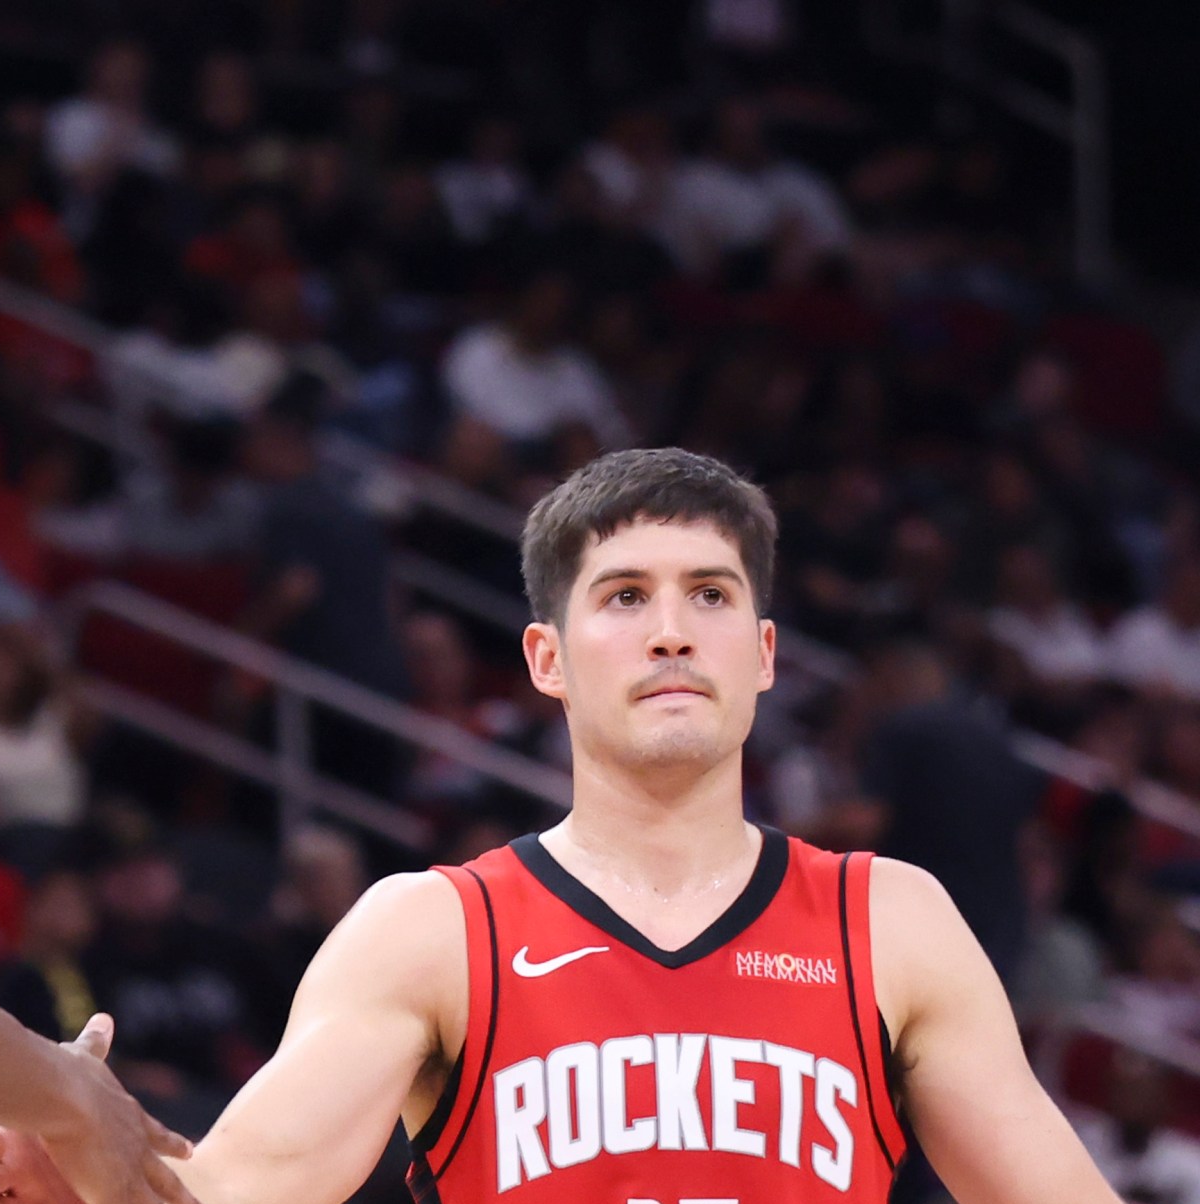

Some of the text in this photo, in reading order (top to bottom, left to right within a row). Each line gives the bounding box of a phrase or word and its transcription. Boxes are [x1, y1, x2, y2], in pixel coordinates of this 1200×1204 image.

[736, 951, 835, 972] MEMORIAL
[737, 962, 836, 984] HERMANN
[493, 1033, 857, 1194] ROCKETS
